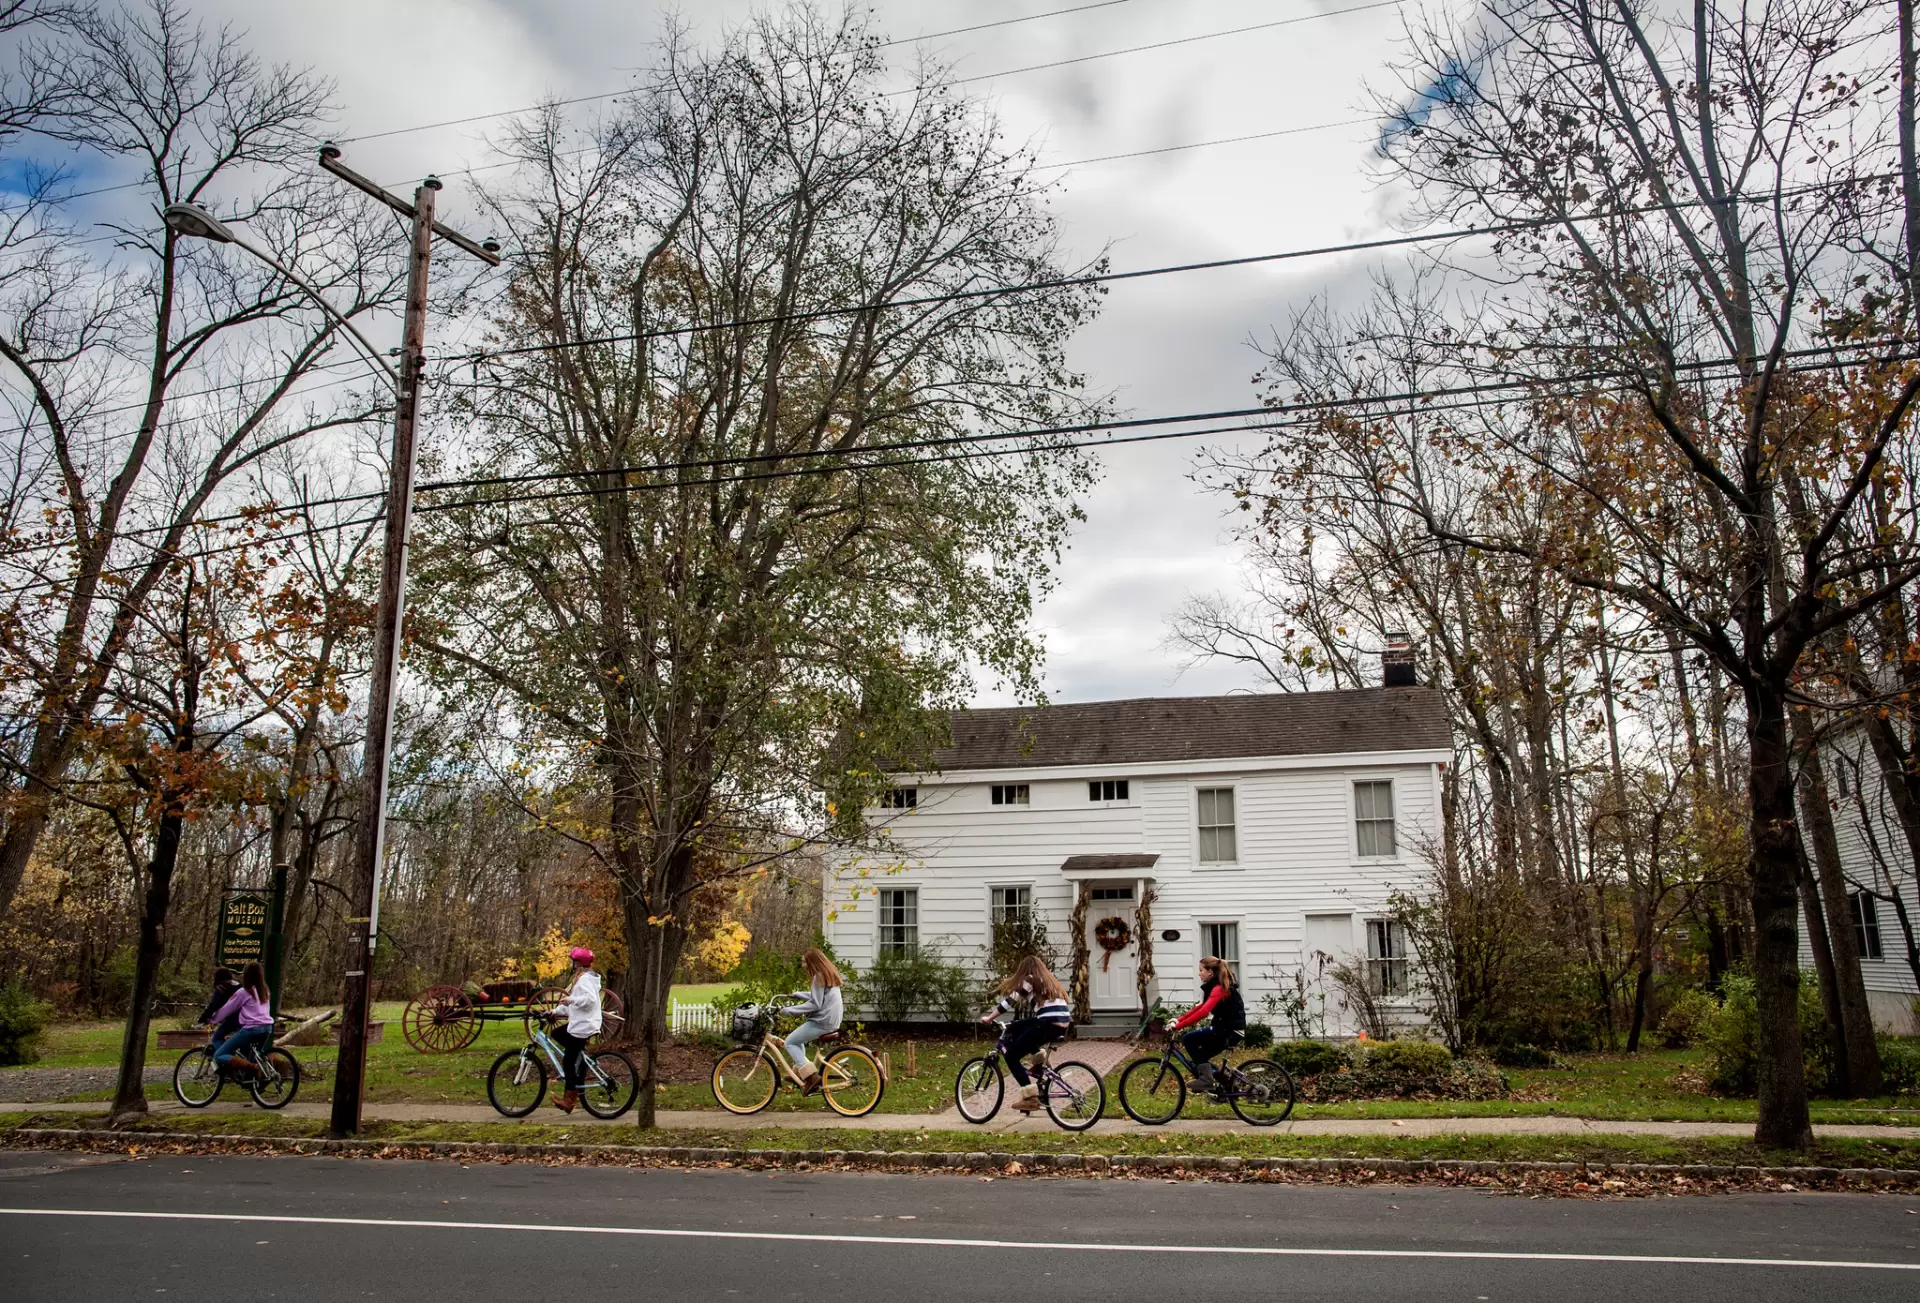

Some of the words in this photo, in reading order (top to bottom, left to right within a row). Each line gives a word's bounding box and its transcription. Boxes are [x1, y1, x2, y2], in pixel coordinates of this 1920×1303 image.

[228, 902, 246, 914] Salt
[248, 903, 266, 914] Box
[227, 916, 264, 924] MUSEUM
